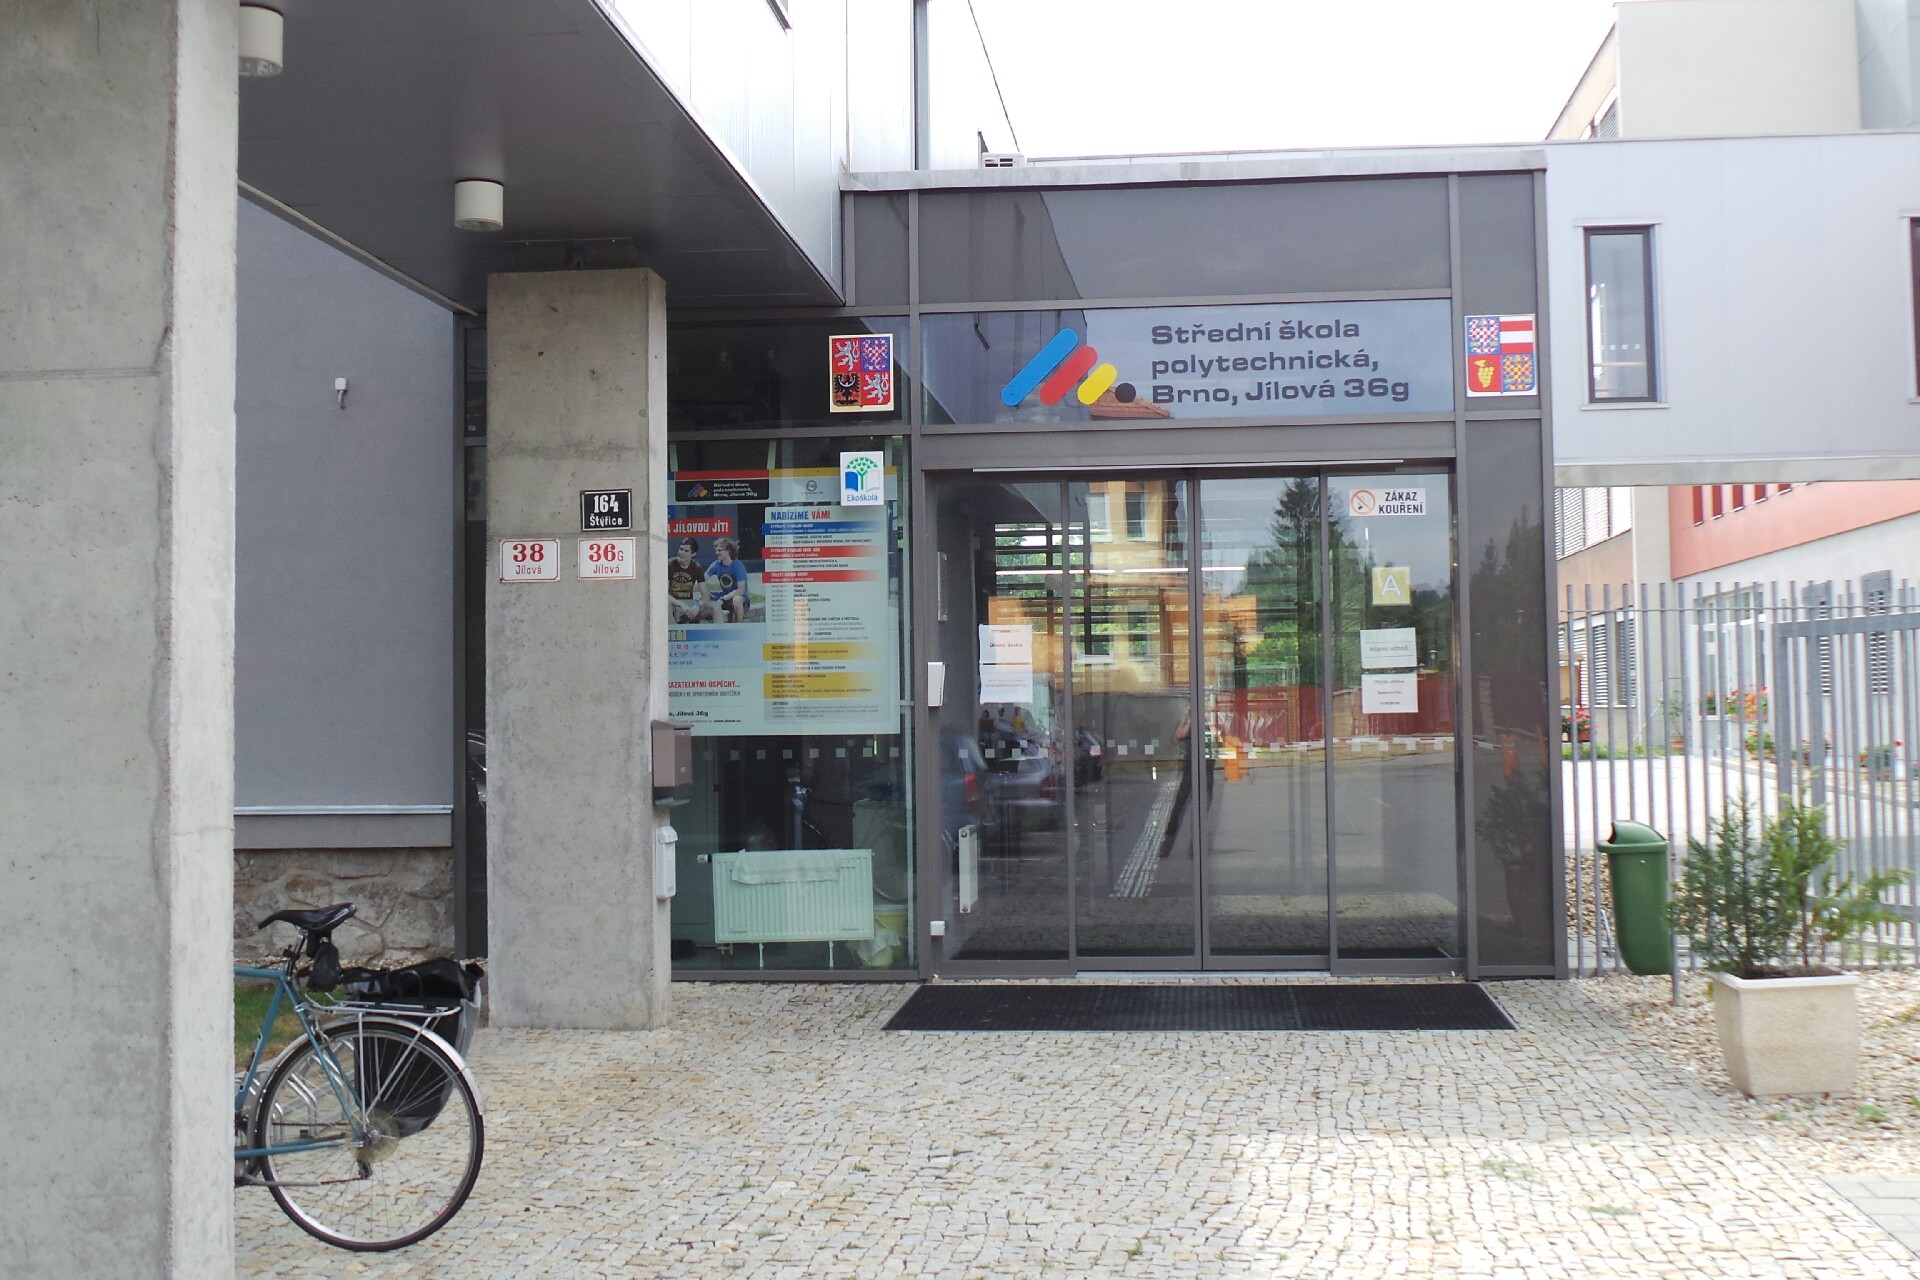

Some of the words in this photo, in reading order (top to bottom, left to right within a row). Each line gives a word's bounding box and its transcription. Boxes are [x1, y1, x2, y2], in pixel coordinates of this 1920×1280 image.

[1151, 321, 1271, 345] Střední
[1279, 319, 1360, 340] škola
[1152, 348, 1378, 380] polytechnická,
[1152, 384, 1238, 406] Brno,
[1245, 379, 1335, 401] Jílová
[1343, 377, 1409, 402] 36g
[847, 494, 878, 502] Ekoškola
[1385, 490, 1417, 502] ZÁKAZ
[593, 494, 619, 513] 164
[1378, 502, 1424, 514] KOUŘENÍ
[589, 513, 623, 527] Štýřice
[770, 509, 809, 521] NABÍZÍME
[811, 508, 831, 520] VÁM!
[673, 520, 710, 533] JÍLOVOU
[712, 519, 729, 532] JÍT!
[512, 543, 545, 563] 38
[588, 543, 624, 562] 36G
[515, 564, 542, 576] Jílová
[592, 563, 620, 575] Jílová
[1380, 573, 1401, 597] A
